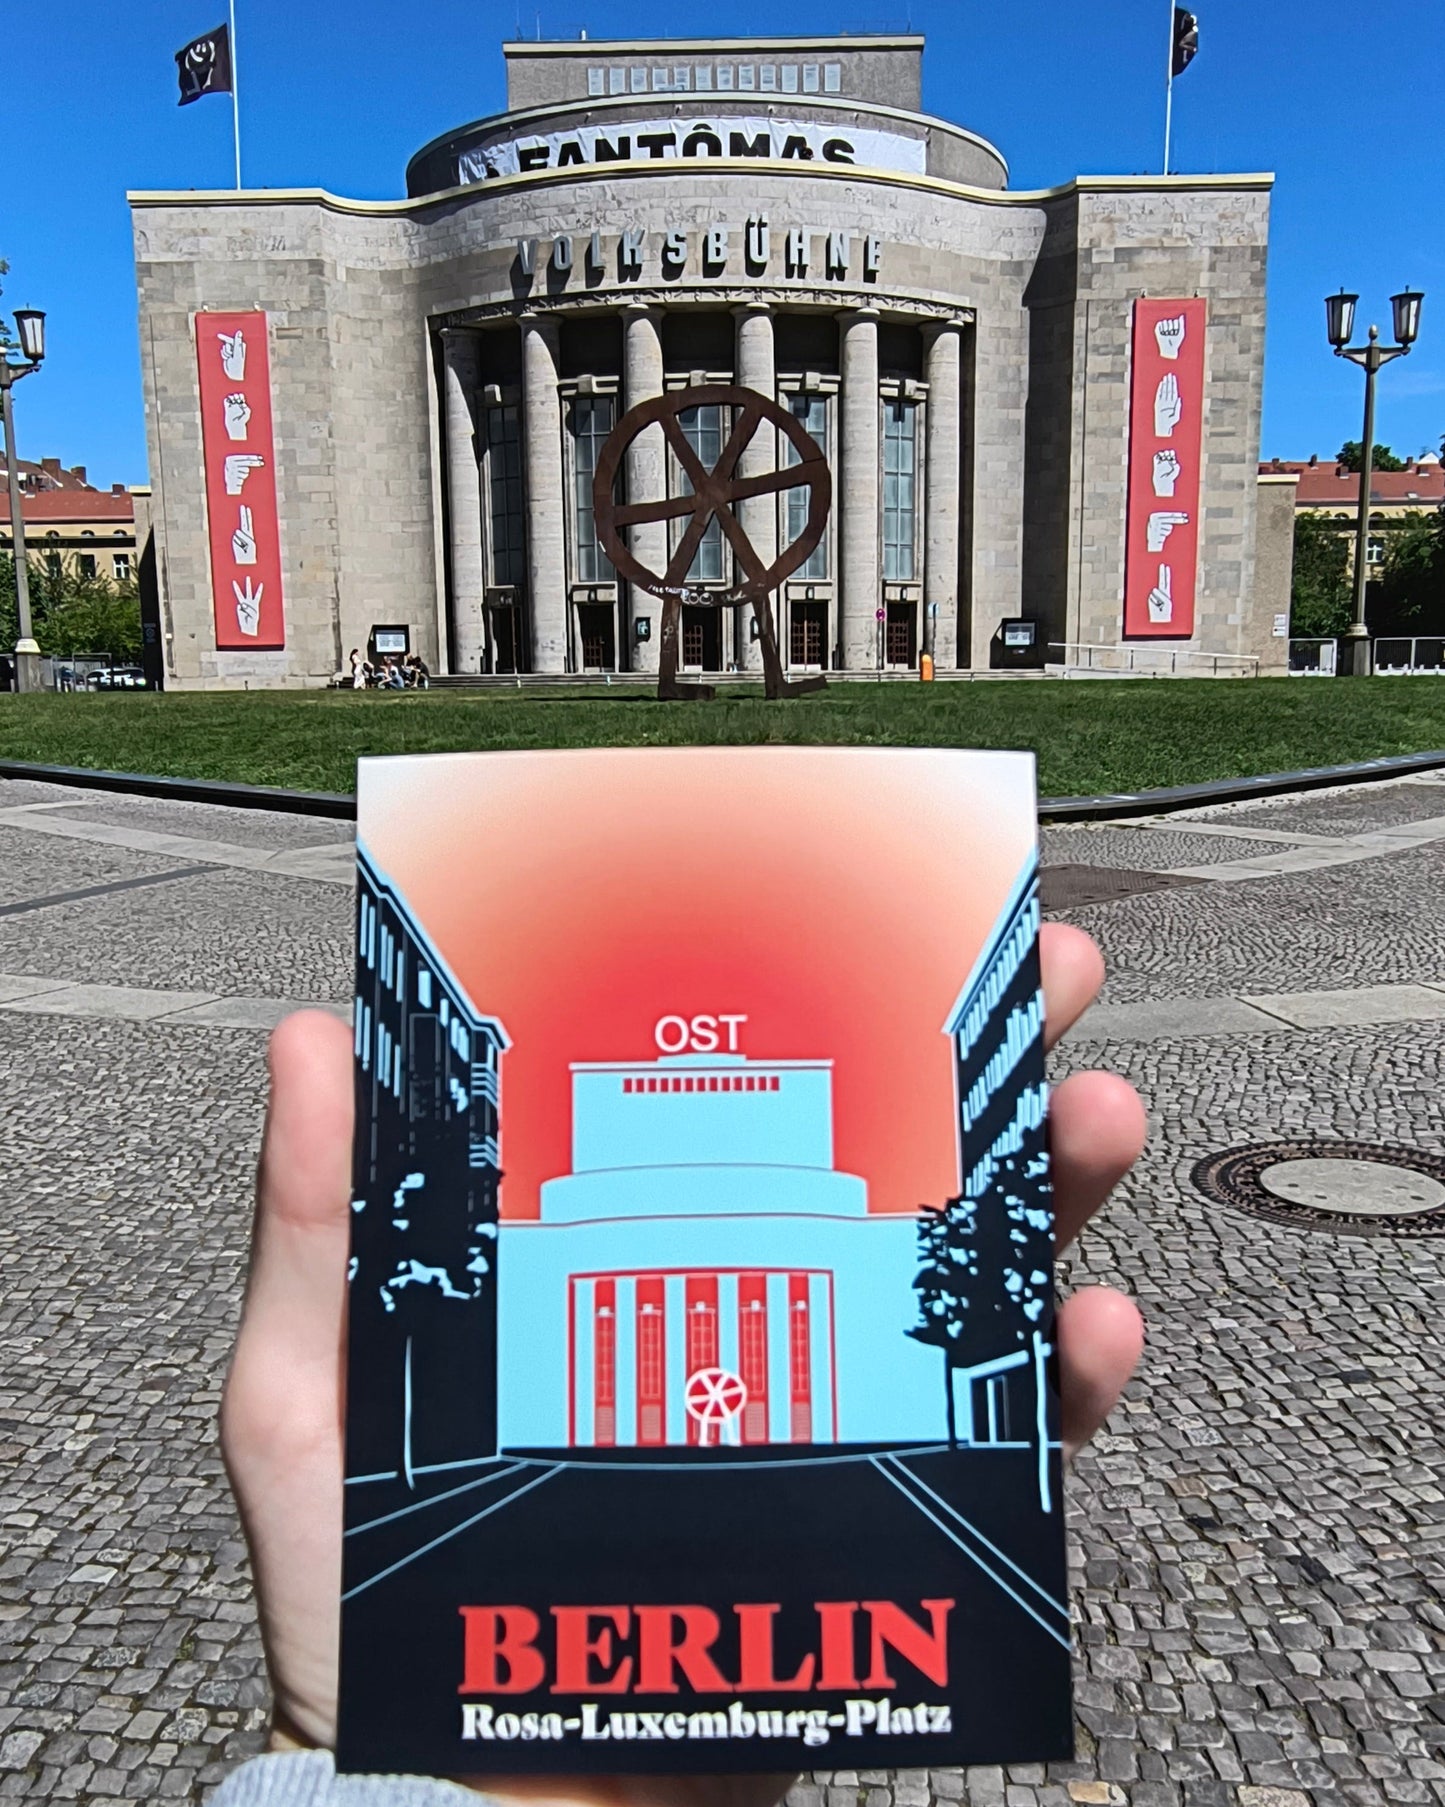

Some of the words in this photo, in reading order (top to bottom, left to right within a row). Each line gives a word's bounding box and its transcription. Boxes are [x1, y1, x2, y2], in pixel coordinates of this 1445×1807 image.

[519, 123, 855, 173] FANTÔMAS
[516, 212, 882, 276] VOLKSBÜHNE
[655, 1014, 748, 1053] OST
[457, 1598, 955, 1696] BERLIN
[461, 1698, 952, 1747] Rosa-Luxemburg-Platz
